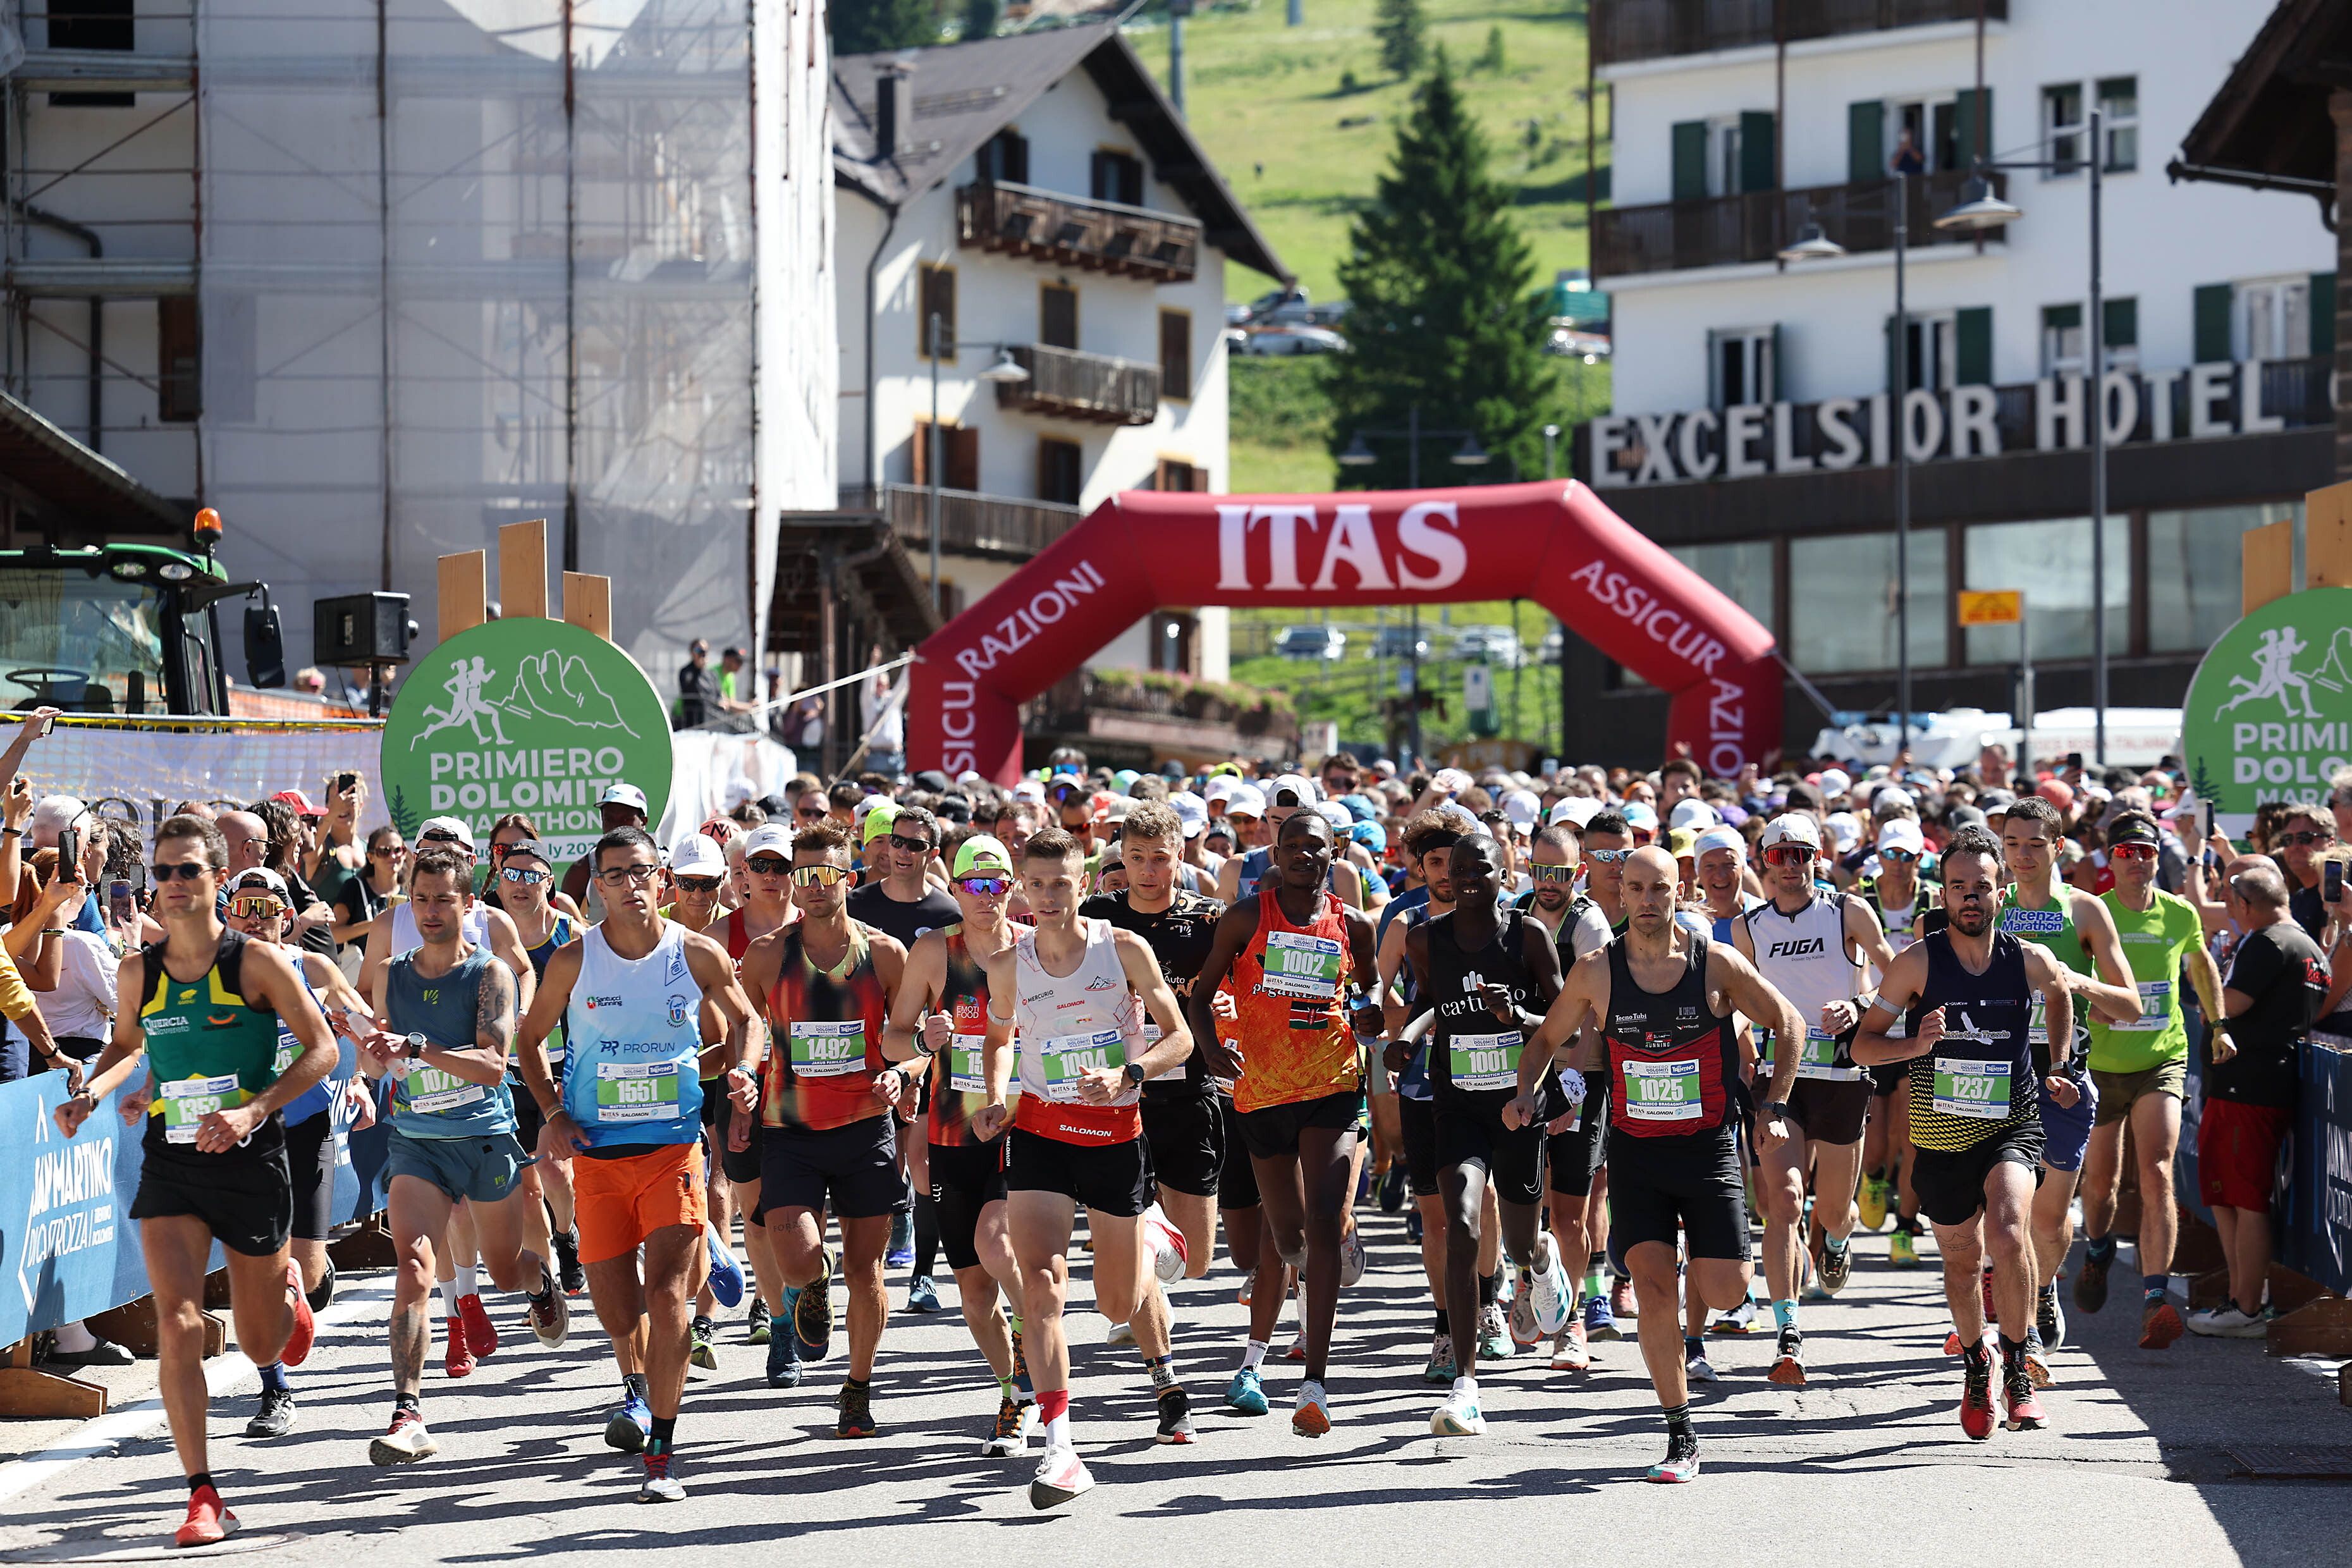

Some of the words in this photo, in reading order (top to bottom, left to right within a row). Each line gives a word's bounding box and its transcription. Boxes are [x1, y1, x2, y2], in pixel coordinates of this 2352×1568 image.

[1589, 384, 2000, 489] EXCELSIOR
[2038, 360, 2284, 451] HOTEL
[1214, 501, 1467, 591] ITAS
[430, 747, 624, 780] PRIMIERO
[431, 778, 624, 811] DOLOMIT
[2004, 907, 2063, 922] Vicenza
[2001, 920, 2063, 932] Marathon
[1318, 941, 1337, 950] TRENTINO
[1768, 938, 1825, 958] FUGA
[1283, 950, 1325, 976] 1002
[1165, 976, 1185, 984] Auto
[1027, 989, 1054, 1003] MERCURIO
[1057, 1000, 1085, 1010] SALOMON
[142, 1015, 189, 1035] QUERCIA
[1944, 1031, 1981, 1040] Atletica
[1981, 1030, 2011, 1039] Trento
[623, 1043, 675, 1053] PRORUN
[1093, 1032, 1116, 1043] TRENTINO
[1498, 1035, 1519, 1043] TRENTINO
[807, 1038, 850, 1060] 1492
[1060, 1049, 1110, 1077] 1004
[1469, 1049, 1508, 1073] 1001
[616, 1079, 658, 1103] 1551
[1639, 1079, 1683, 1101] 1025
[1952, 1075, 1995, 1099] 1237
[177, 1096, 222, 1123] 1352
[1059, 1124, 1112, 1137] SALOMON
[52, 1137, 112, 1208] MARTINO
